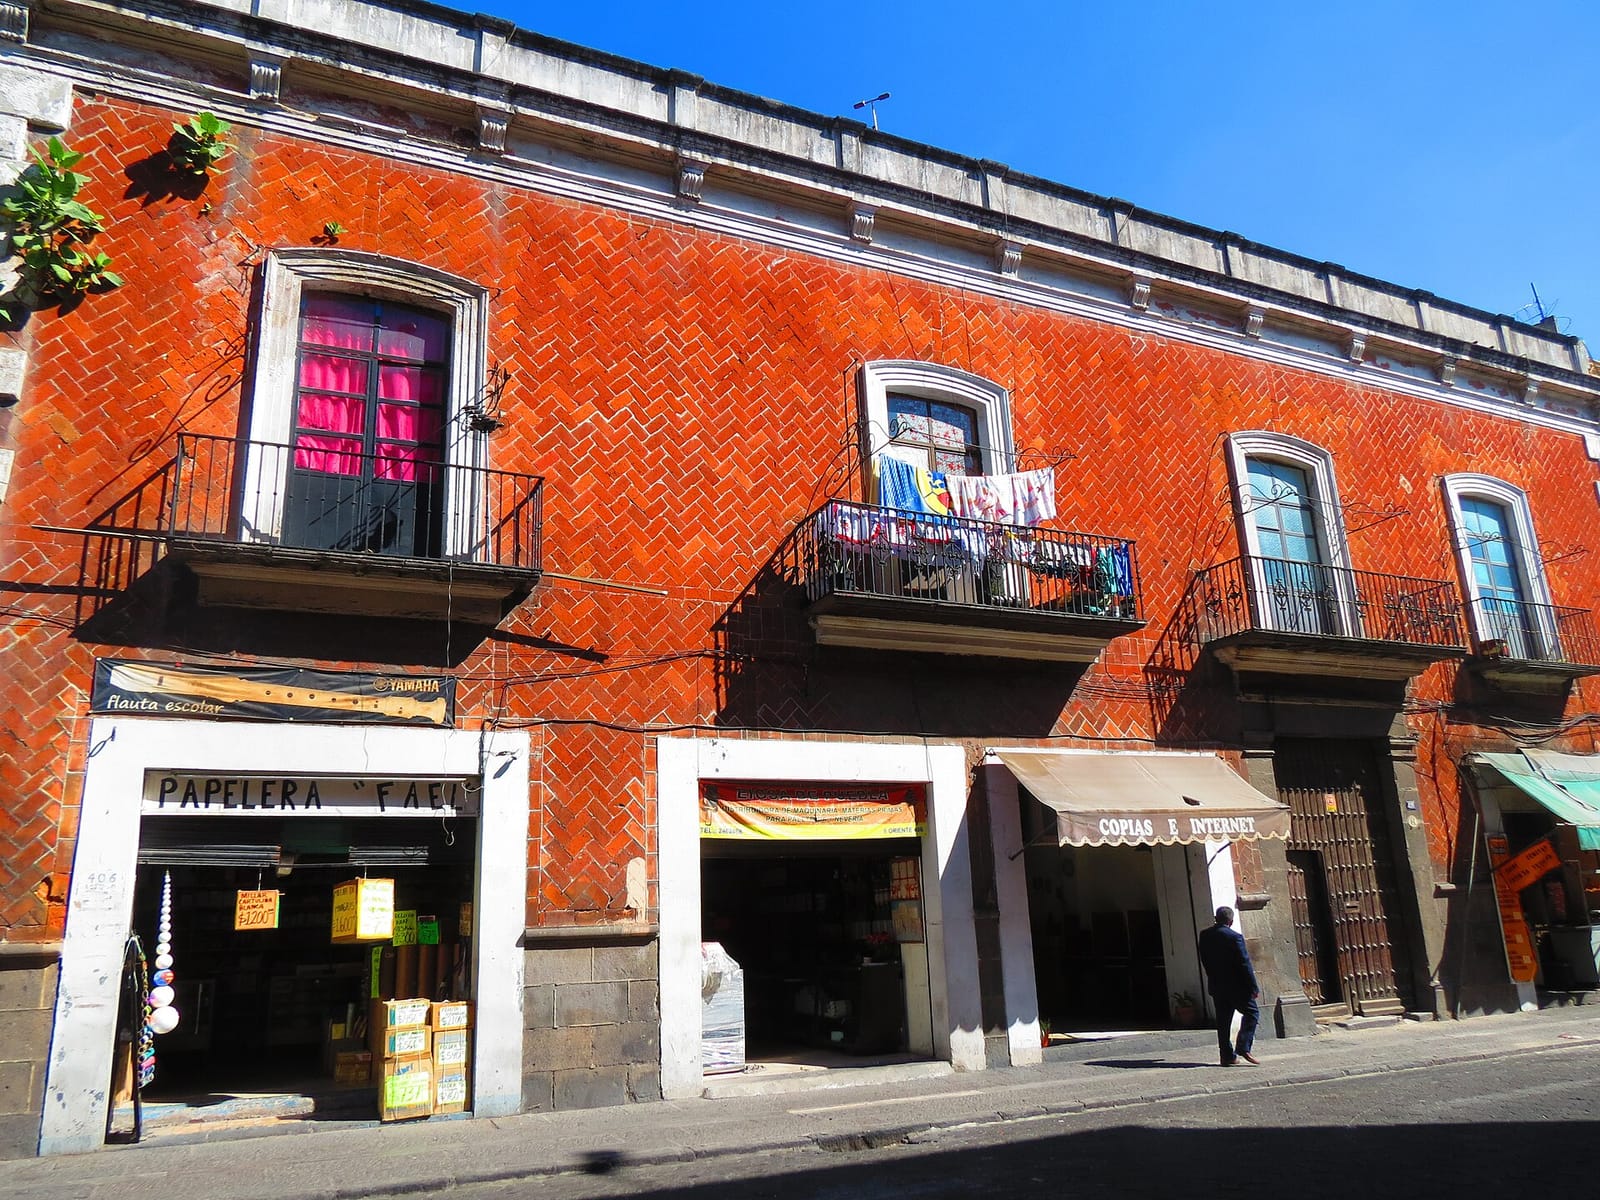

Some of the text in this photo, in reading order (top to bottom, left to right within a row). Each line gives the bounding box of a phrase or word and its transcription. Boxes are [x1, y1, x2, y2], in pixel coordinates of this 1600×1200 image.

[390, 679, 439, 692] YAMAHA
[106, 694, 225, 715] flauta escolar
[159, 777, 322, 810] PAPELERA
[781, 806, 791, 814] DE
[842, 806, 875, 814] MATERIAS
[877, 805, 903, 813] PRIMAS
[765, 815, 785, 823] PARA
[1099, 816, 1256, 836] COPIAS E INTERNET
[87, 872, 117, 884] 406
